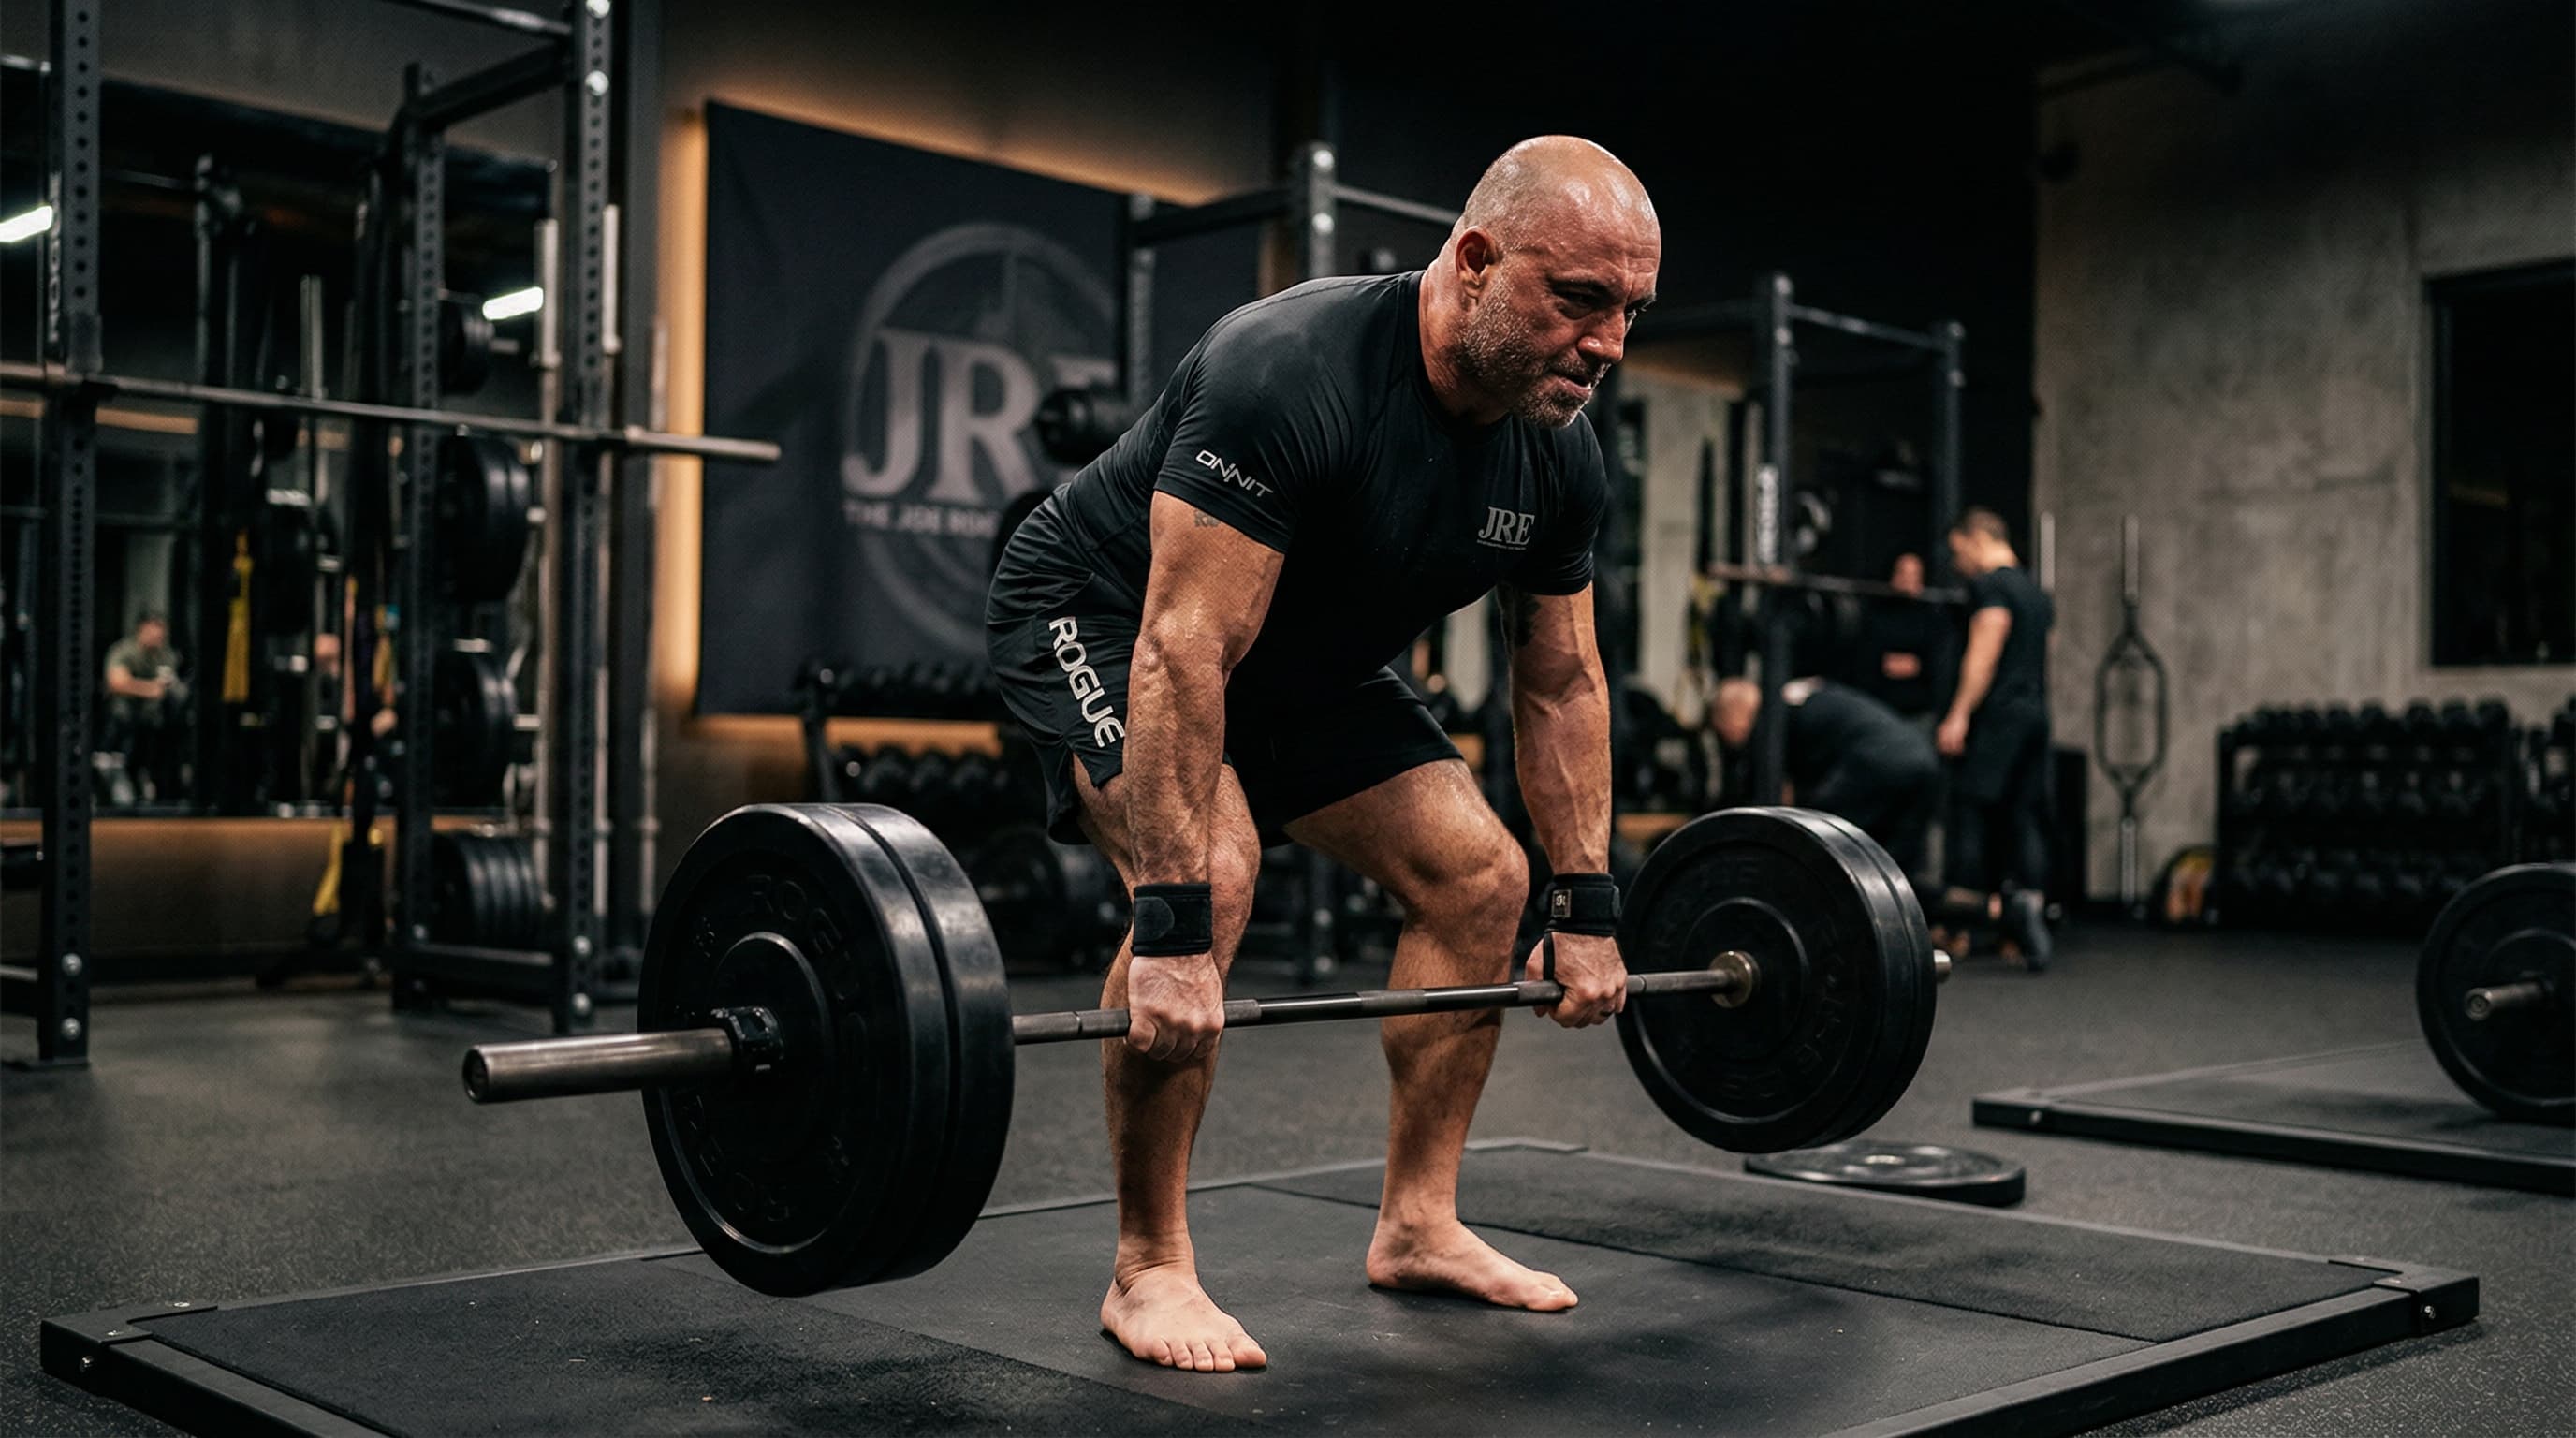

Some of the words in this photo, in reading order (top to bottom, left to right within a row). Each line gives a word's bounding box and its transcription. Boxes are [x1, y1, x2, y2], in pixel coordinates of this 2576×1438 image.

[1195, 449, 1274, 497] ONNIT
[1477, 506, 1535, 545] JRE
[1048, 615, 1126, 748] ROGUE
